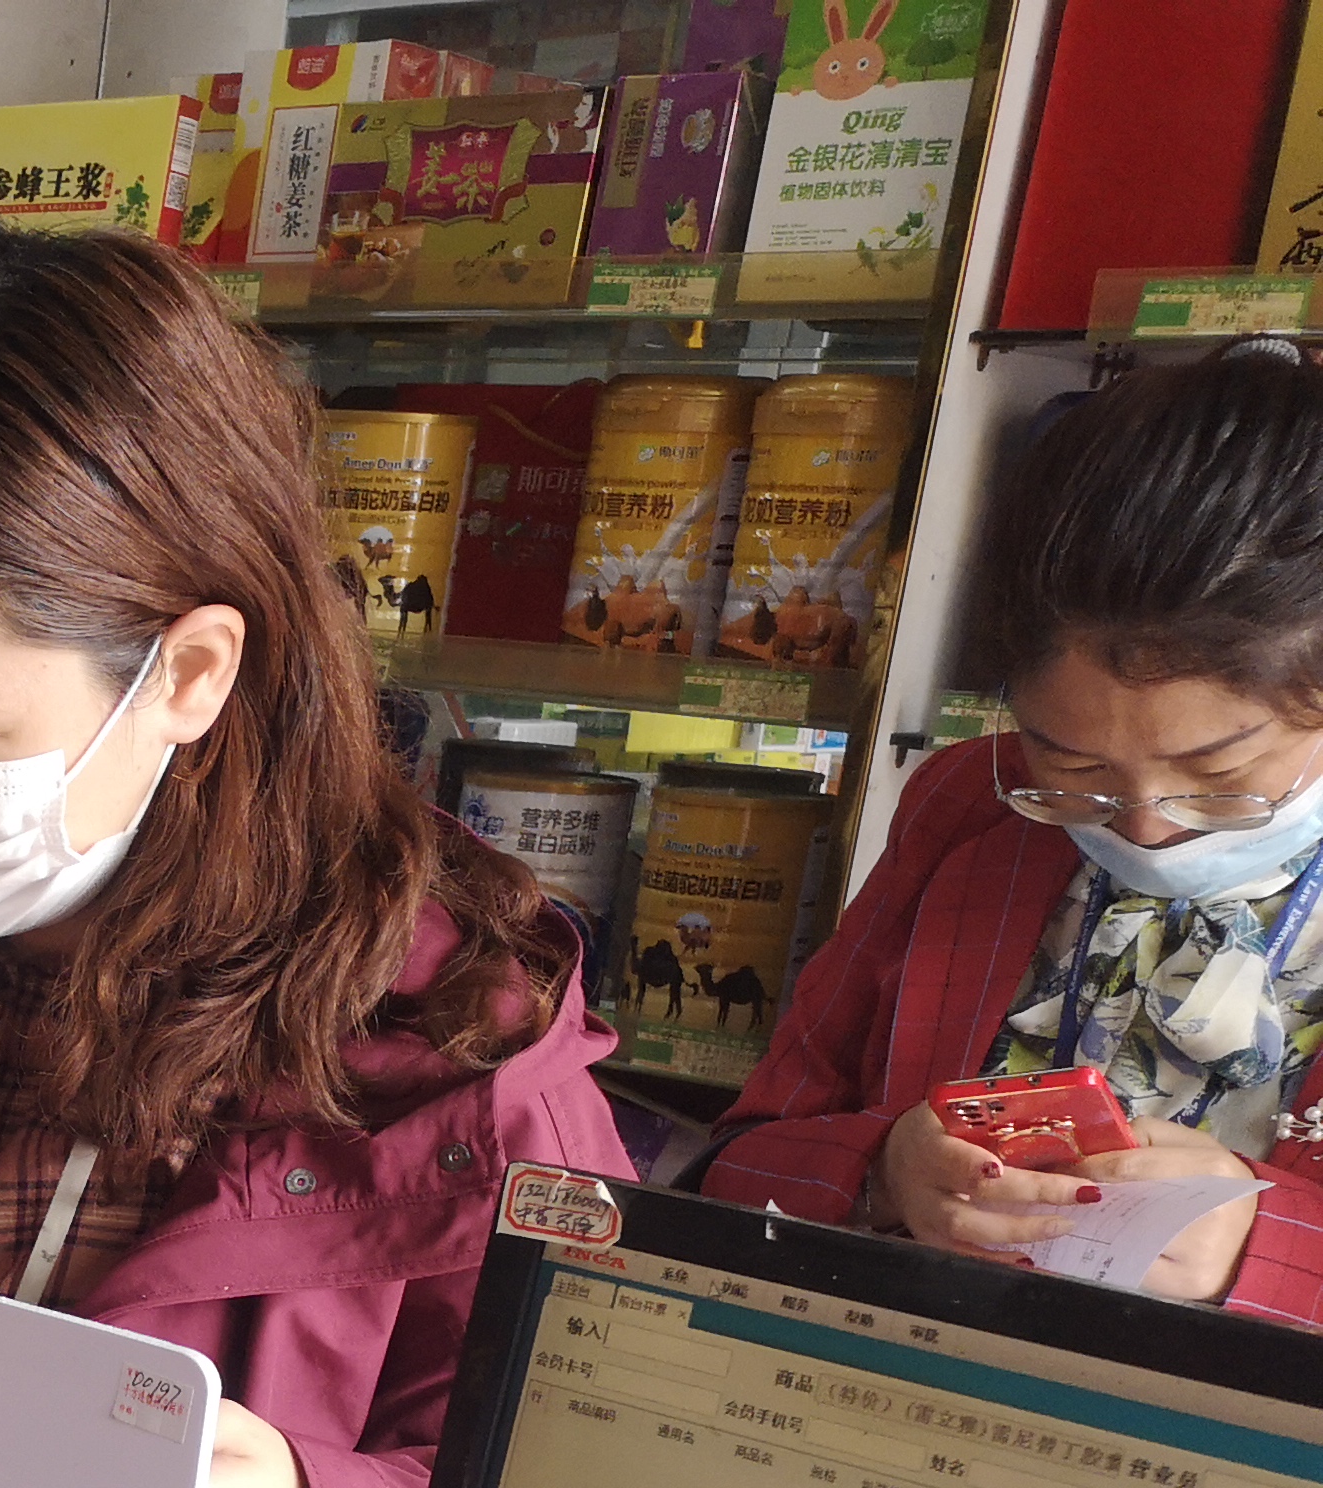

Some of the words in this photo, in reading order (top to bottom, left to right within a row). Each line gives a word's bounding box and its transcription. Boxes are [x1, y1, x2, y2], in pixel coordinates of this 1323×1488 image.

[841, 110, 905, 134] Qing
[785, 138, 953, 174] 金银花清清宝
[279, 127, 316, 239] 红糖姜茶
[779, 179, 886, 203] 植物固体饮料
[520, 807, 601, 832] 营养多维
[516, 831, 597, 856] 蛋白质粉
[556, 1278, 591, 1298] 主控台
[618, 1294, 668, 1317] 前台开票
[566, 1316, 602, 1340] 输入
[774, 1369, 813, 1394] 商品
[535, 1352, 593, 1379] 会员卡号
[723, 1400, 804, 1434] 会员手机号
[930, 1453, 965, 1477] 姓名
[657, 1423, 695, 1445] 通用名
[734, 1444, 773, 1467] 商品名
